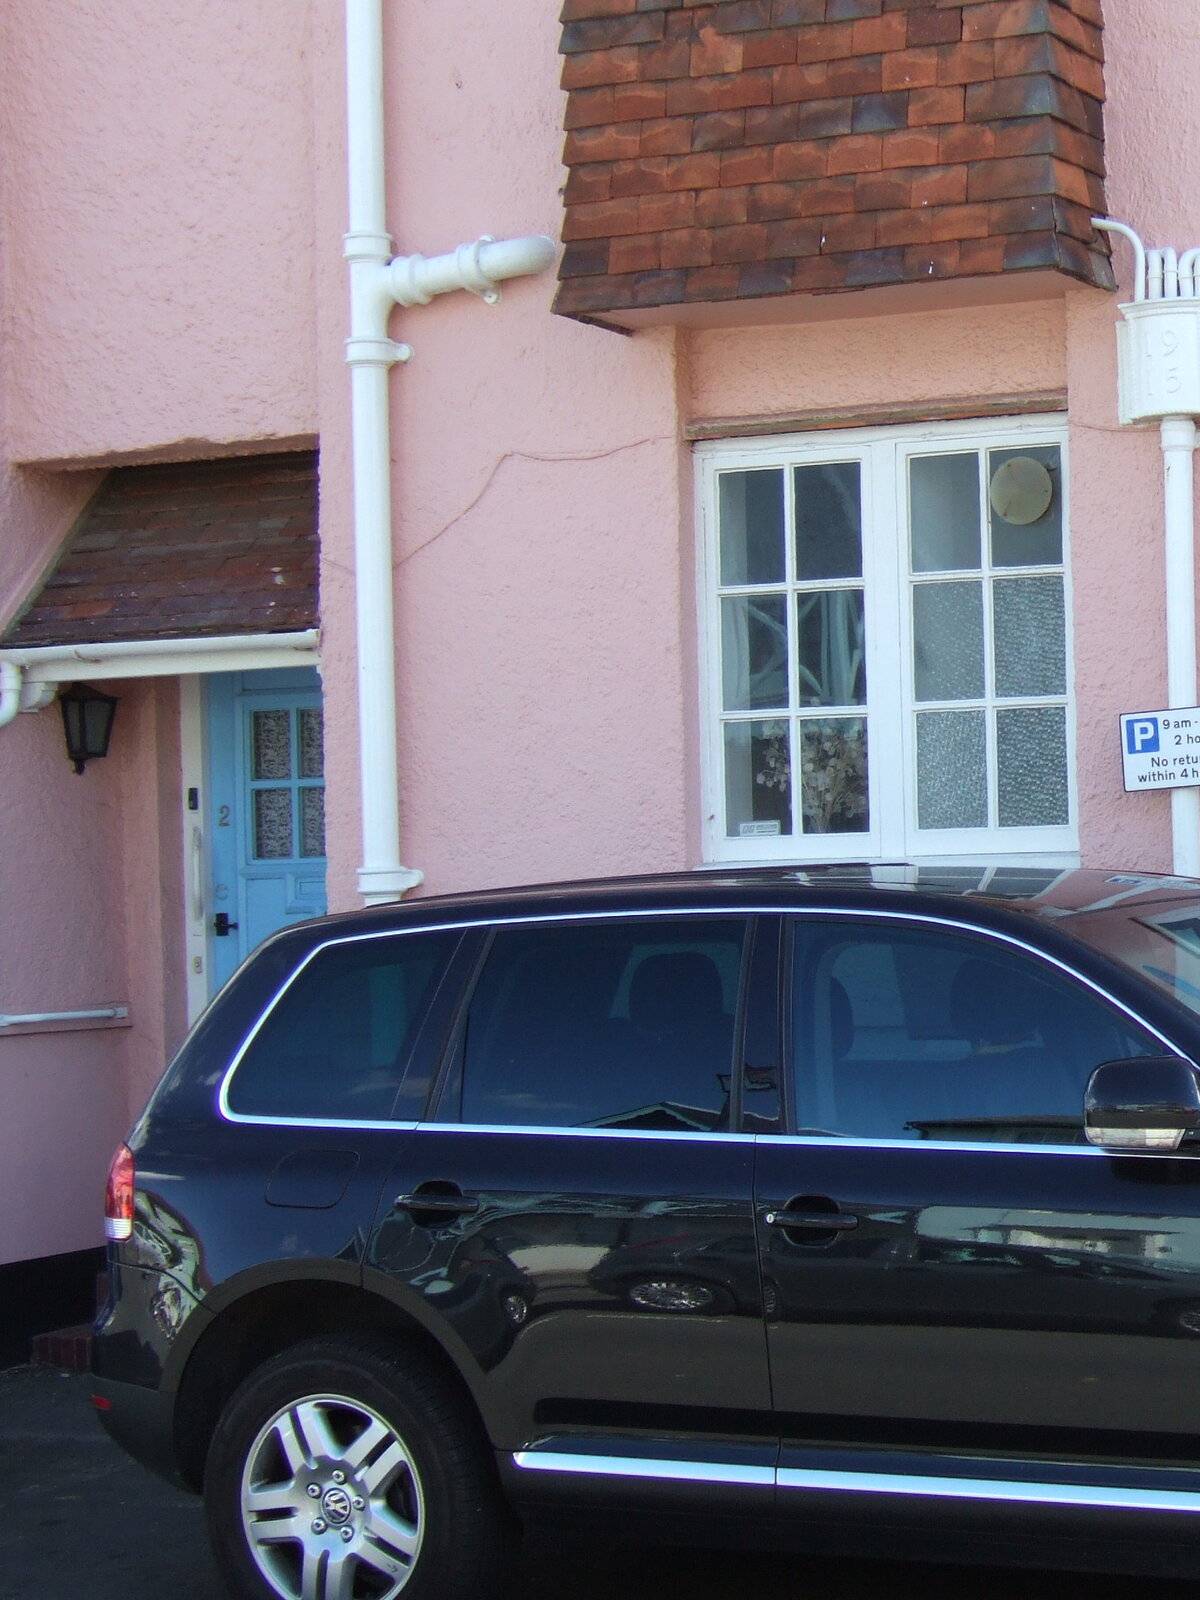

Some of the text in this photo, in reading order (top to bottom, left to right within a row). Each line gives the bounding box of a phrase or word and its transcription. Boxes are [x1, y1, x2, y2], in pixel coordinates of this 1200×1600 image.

[1134, 722, 1154, 750] P
[1175, 735, 1182, 745] 2
[1152, 757, 1168, 767] No
[1138, 771, 1175, 782] within
[1180, 769, 1188, 778] 4
[218, 804, 231, 827] 2
